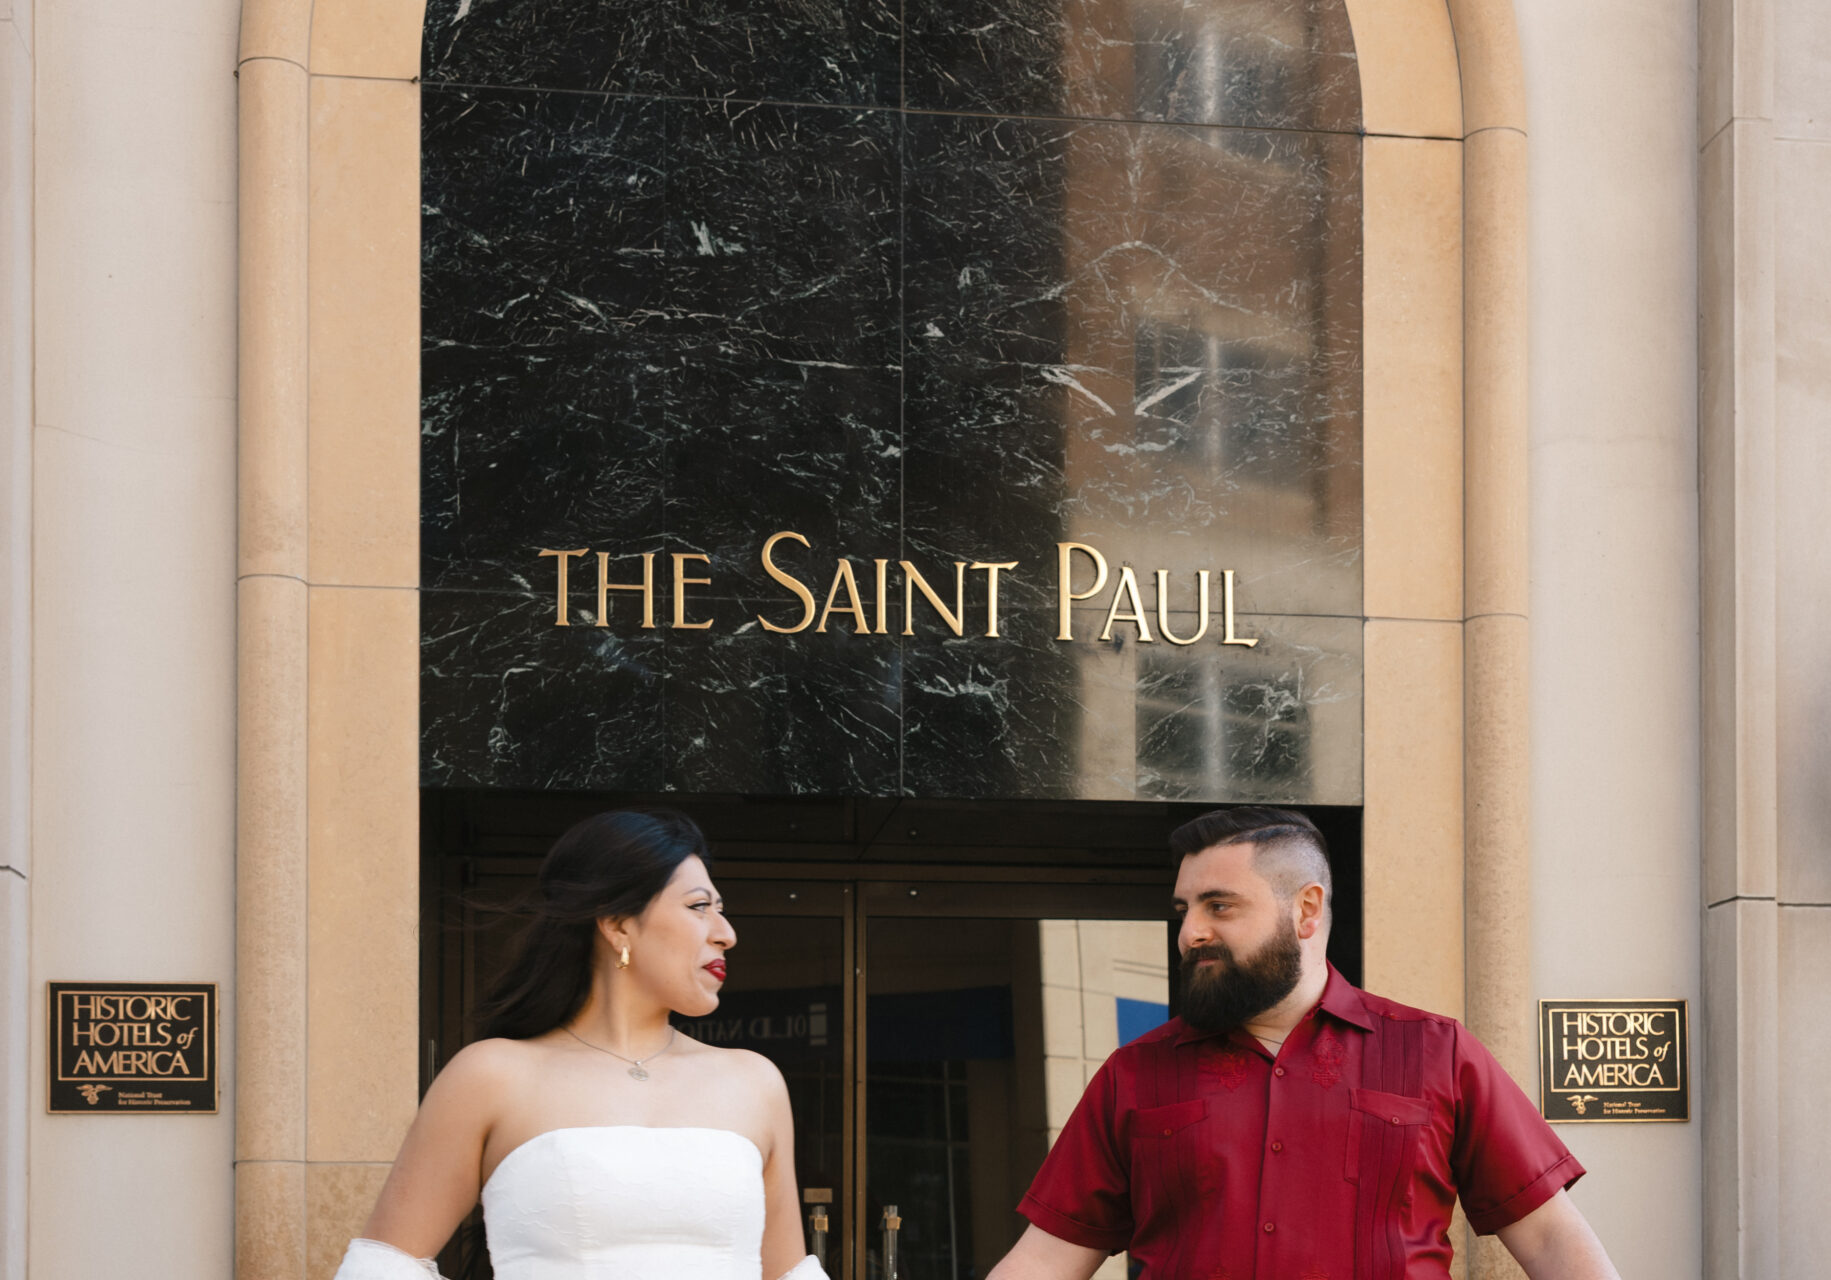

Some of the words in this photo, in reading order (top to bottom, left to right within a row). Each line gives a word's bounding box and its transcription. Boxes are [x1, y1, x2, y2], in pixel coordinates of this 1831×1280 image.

[537, 547, 715, 630] THE
[757, 530, 1020, 639] SAINT
[1056, 541, 1260, 647] PAUL
[73, 995, 191, 1021] HISTORIC
[73, 1022, 172, 1046] HOTELS
[176, 1026, 199, 1050] of
[1562, 1012, 1665, 1036] HISTORIC
[73, 1049, 190, 1075] AMERICA
[1562, 1036, 1649, 1060] HOTELS
[1653, 1041, 1672, 1063] of
[1563, 1062, 1665, 1086] AMERICA
